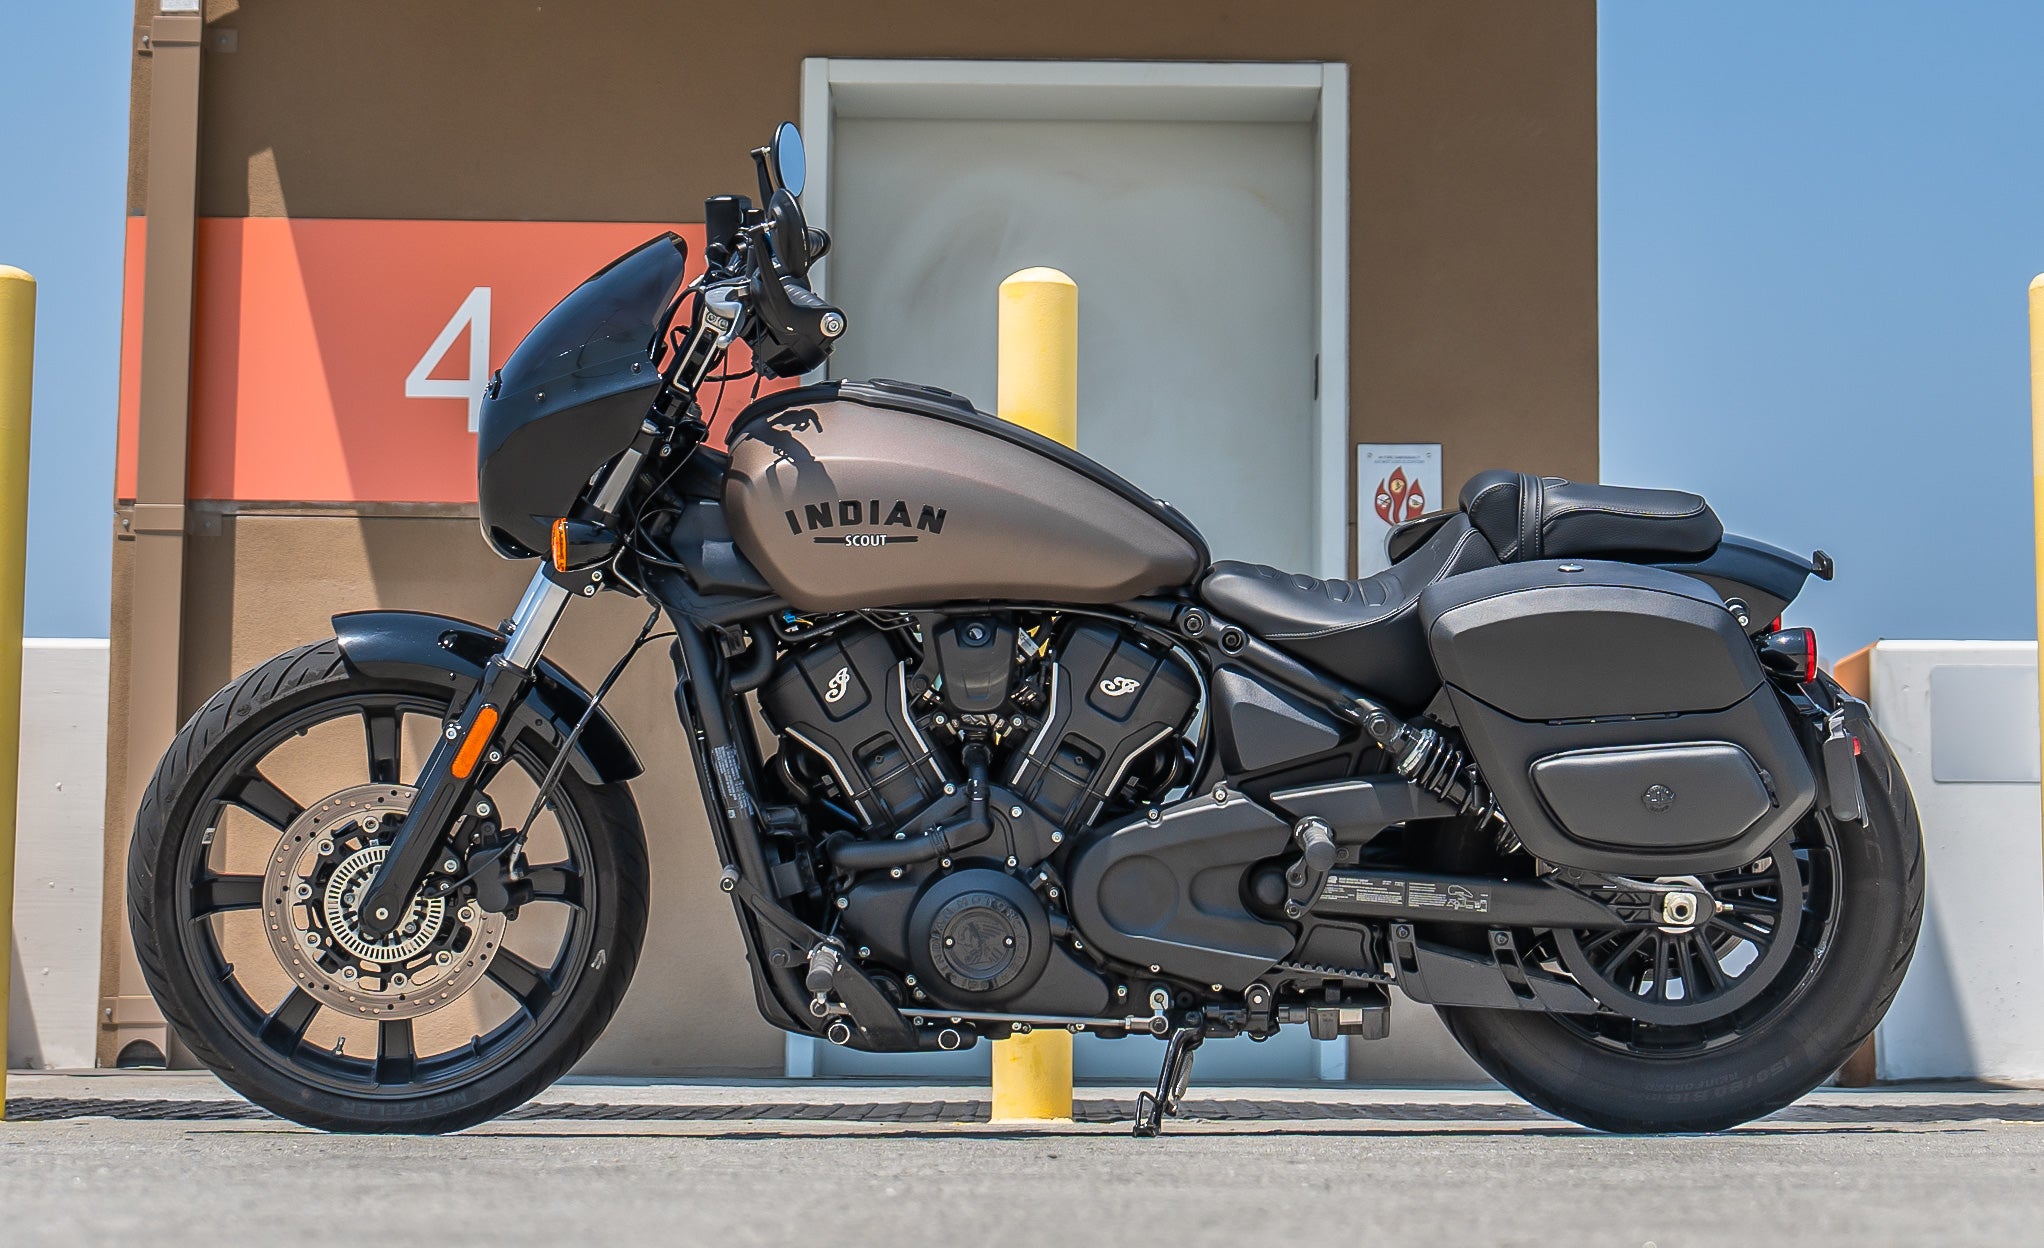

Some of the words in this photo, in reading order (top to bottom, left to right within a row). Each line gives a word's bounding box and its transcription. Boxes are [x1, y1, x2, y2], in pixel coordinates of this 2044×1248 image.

[405, 286, 491, 433] 4
[785, 499, 947, 535] INDIAN
[845, 534, 887, 547] SCOUT
[339, 1092, 466, 1116] METZELER
